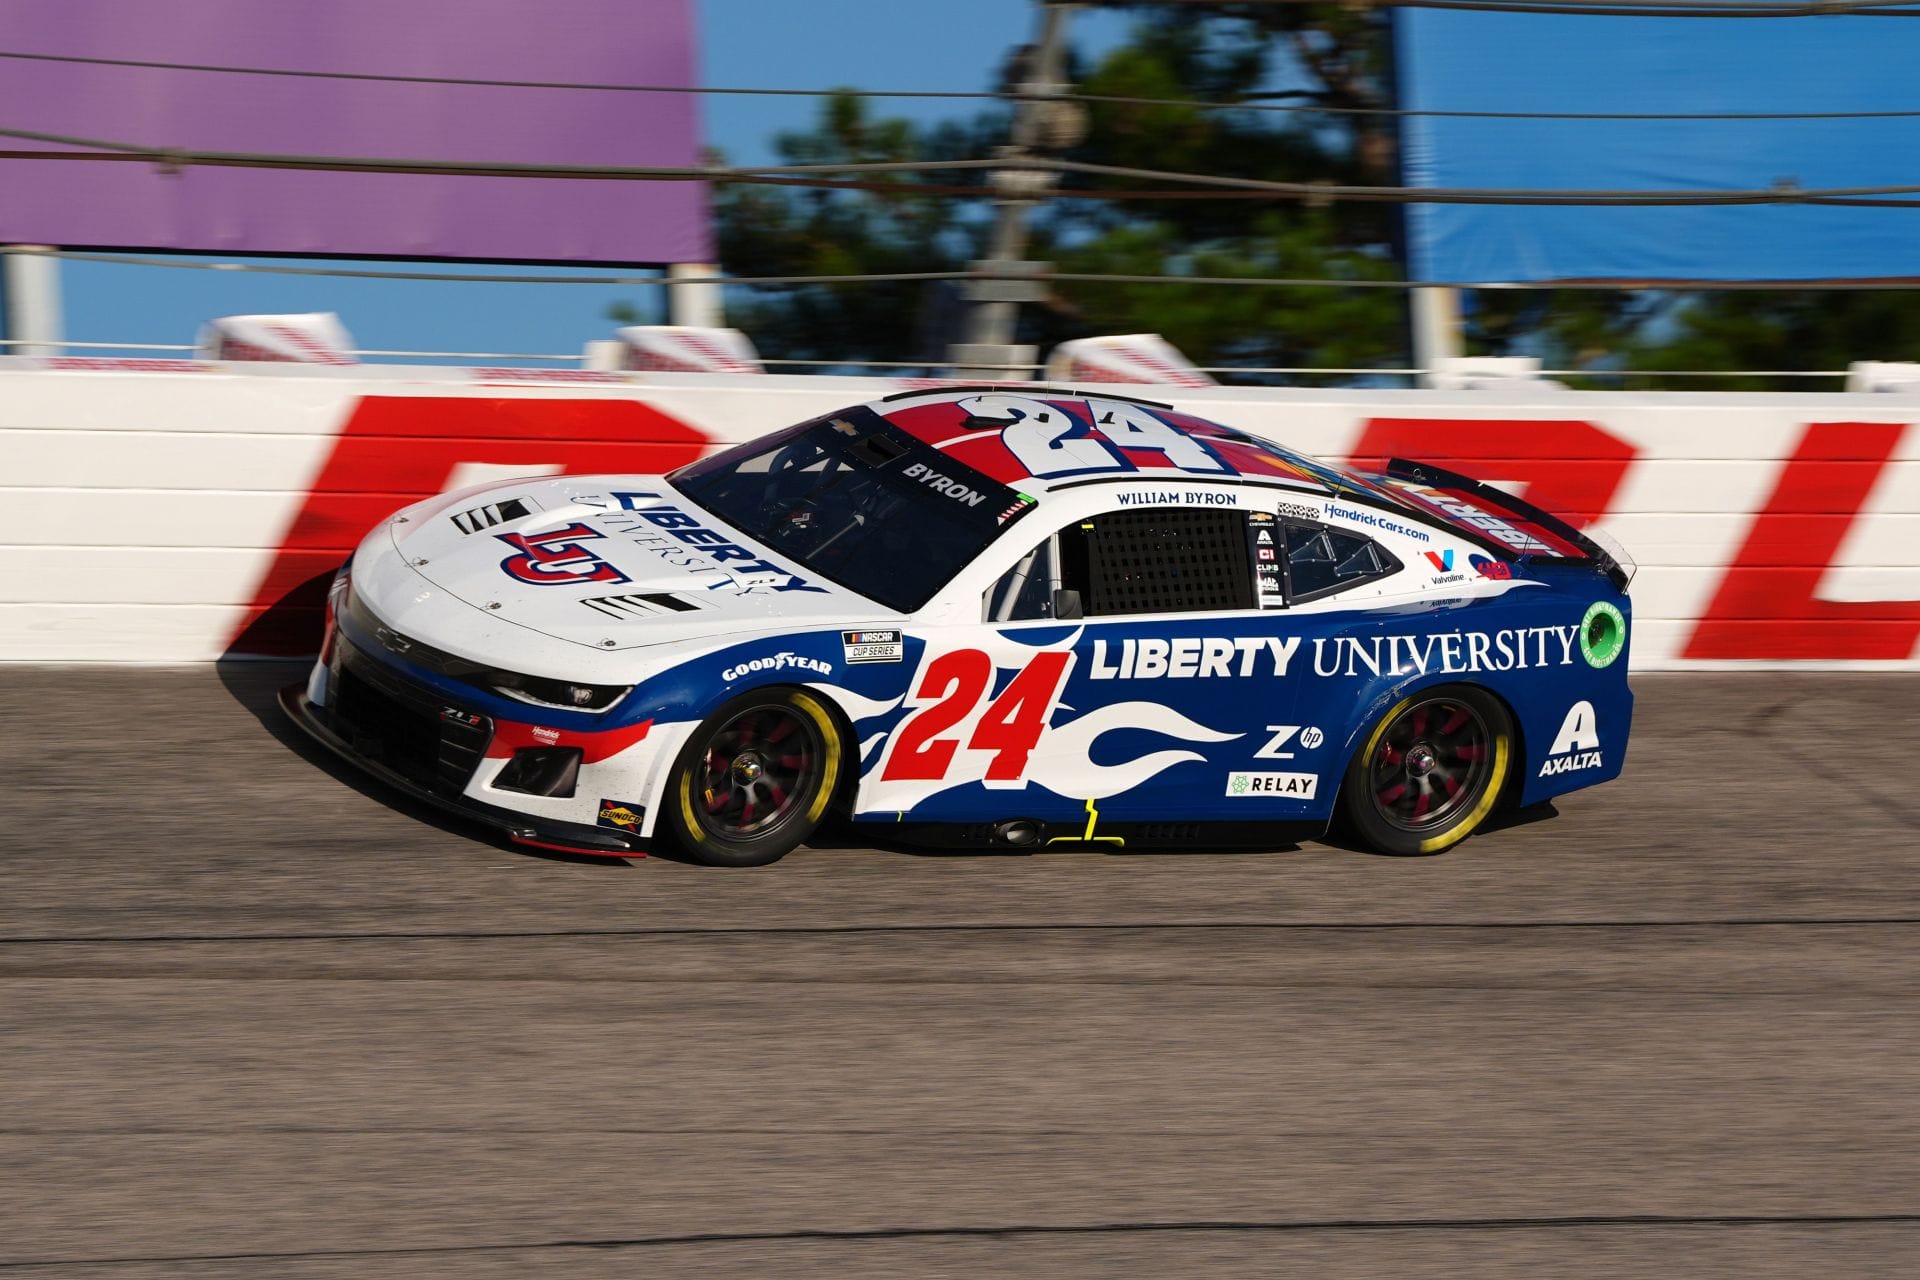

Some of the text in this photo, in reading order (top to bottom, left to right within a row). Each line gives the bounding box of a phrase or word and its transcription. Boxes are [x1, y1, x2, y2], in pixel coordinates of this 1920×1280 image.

[957, 396, 1240, 479] 24
[902, 463, 987, 508] BYRON
[1116, 492, 1237, 505] WILLIAM BYRON
[609, 492, 833, 594] LIBERTY
[1431, 574, 1465, 585] Valvoline
[853, 645, 894, 657] CUP SERIES
[862, 632, 893, 643] NASCAR
[1090, 625, 1580, 678] LIBERTY UNIVERSITY
[722, 652, 832, 682] GOODYEAR
[880, 648, 1070, 782] 24
[1253, 725, 1301, 759] Z
[1302, 727, 1323, 749] hp
[1538, 750, 1602, 778] AXALTA
[1251, 777, 1312, 794] RELAY
[601, 809, 641, 824] SUNOCO
